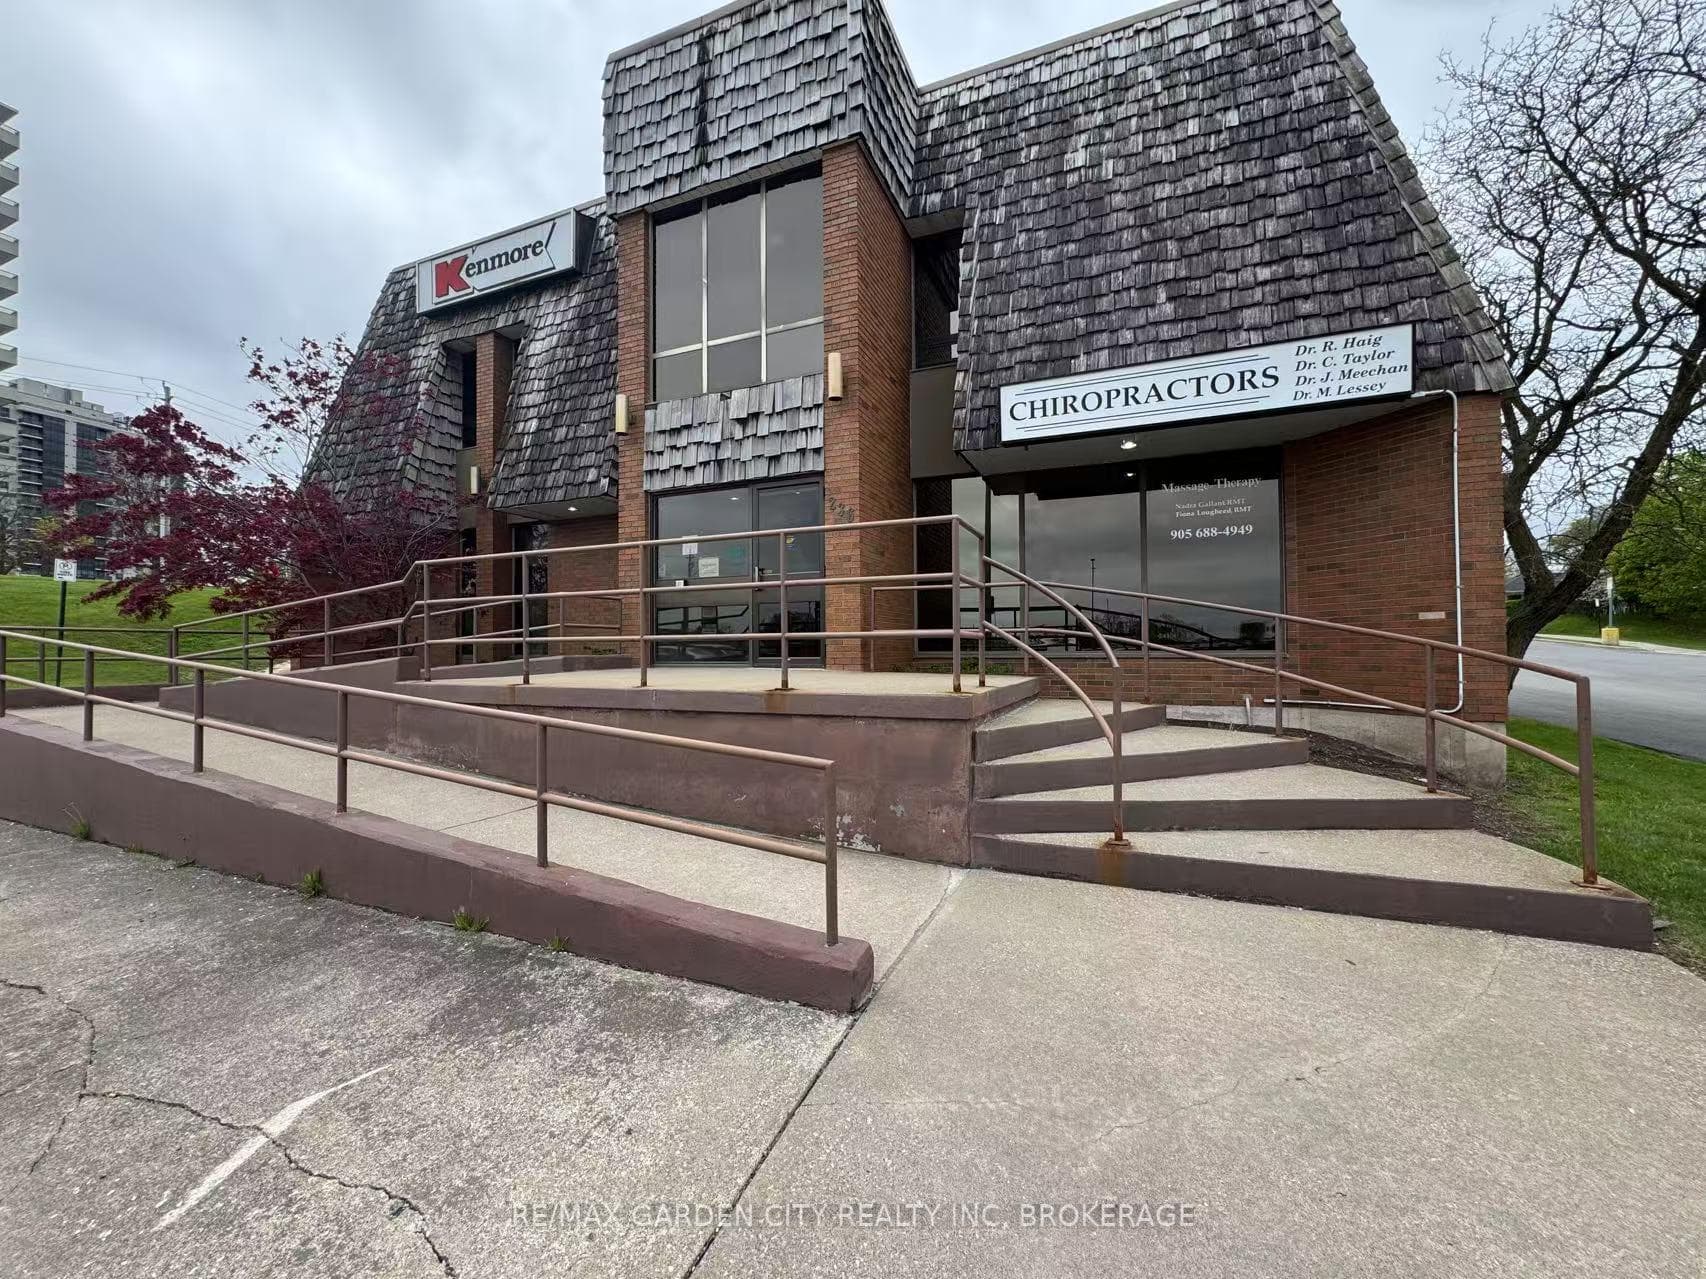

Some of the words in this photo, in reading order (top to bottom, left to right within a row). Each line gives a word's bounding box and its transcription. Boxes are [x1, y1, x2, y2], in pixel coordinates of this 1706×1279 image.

[435, 240, 544, 298] Kenmore
[1294, 345, 1317, 357] Dr.
[1322, 341, 1338, 353] R.
[1342, 334, 1384, 350] Haig
[1295, 360, 1317, 372] Dr.
[1322, 356, 1338, 368] C.
[1343, 349, 1396, 365] Taylor
[1294, 375, 1317, 387] Dr.
[1320, 371, 1334, 384] J.
[1338, 364, 1409, 381] Meechan
[1008, 365, 1280, 422] CHIROPRACTORS
[1292, 390, 1313, 401] Dr.
[1316, 386, 1332, 399] M.
[1336, 381, 1387, 396] Lessey
[1161, 482, 1210, 493] Massage
[1215, 477, 1262, 488] Therapy
[1170, 528, 1193, 541] 905
[1195, 523, 1254, 538] 688-4949
